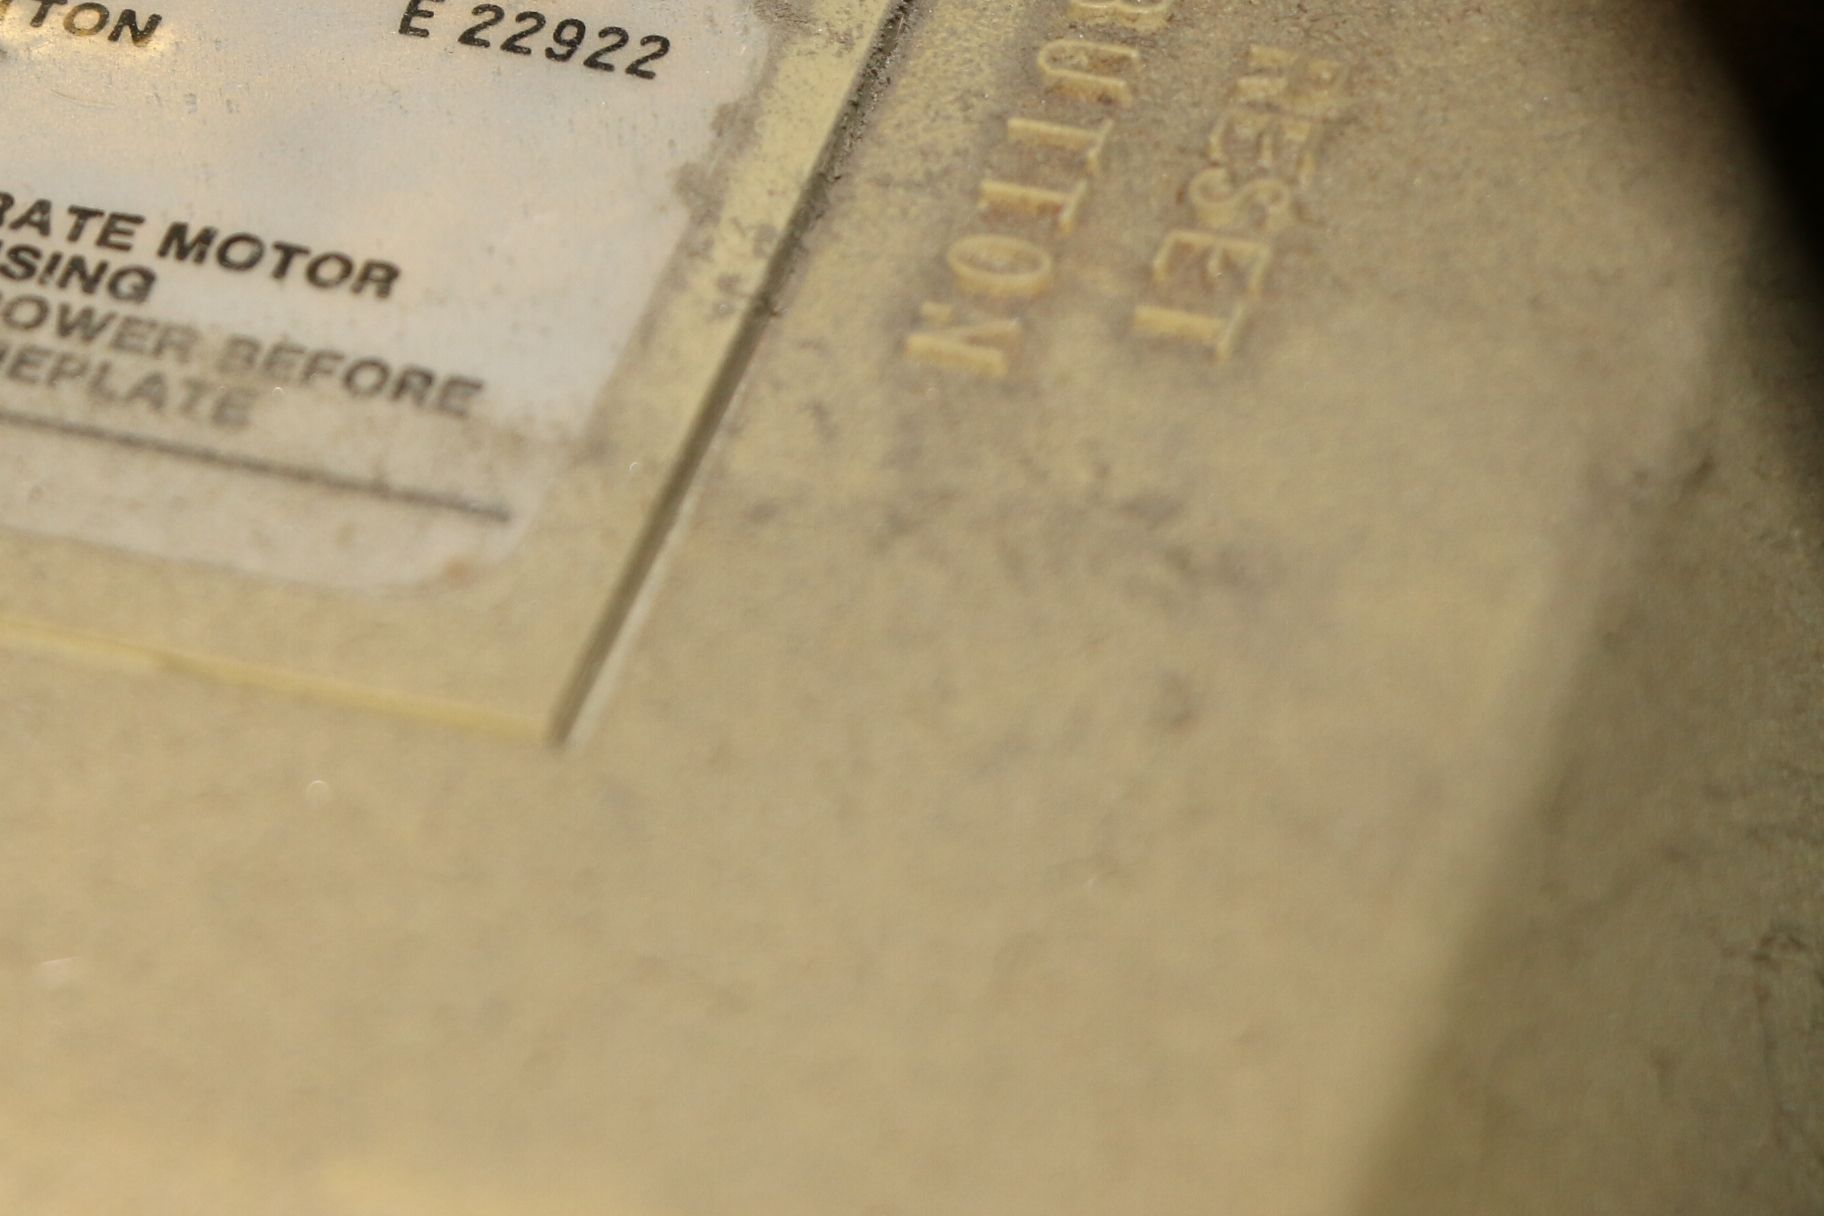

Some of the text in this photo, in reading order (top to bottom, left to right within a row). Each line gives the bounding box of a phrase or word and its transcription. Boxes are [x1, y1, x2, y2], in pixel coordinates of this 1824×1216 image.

[457, 3, 672, 80] 22922
[156, 220, 403, 300] MOTOR
[216, 332, 486, 422] BEFORE
